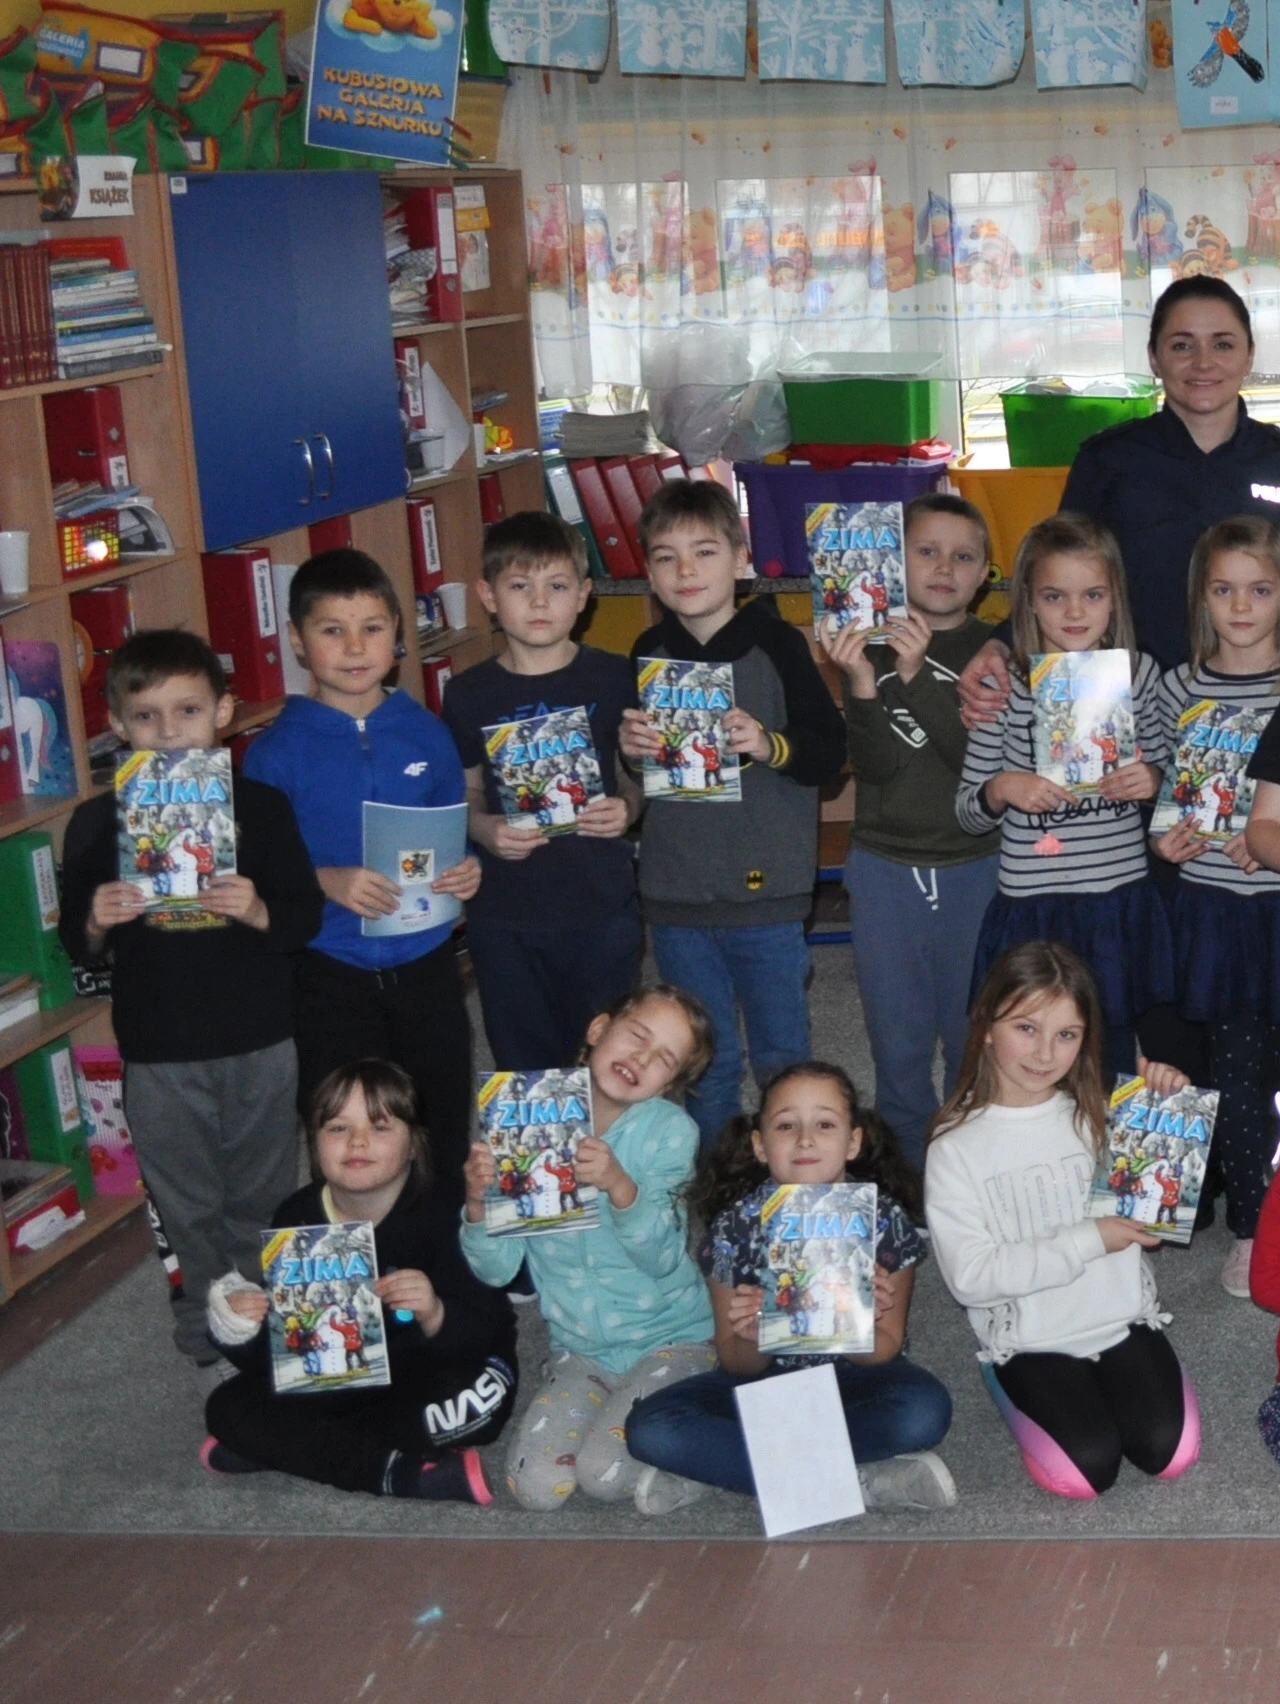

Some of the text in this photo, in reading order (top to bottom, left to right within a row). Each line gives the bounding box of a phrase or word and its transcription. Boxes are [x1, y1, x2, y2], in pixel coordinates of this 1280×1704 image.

[324, 67, 444, 99] KUBUSIOWA
[338, 88, 426, 116] GALERIA
[317, 104, 443, 138] NA SZNURKU
[823, 528, 898, 550] ZIMA
[653, 686, 729, 710] ZIMA
[506, 730, 588, 764] ZIMA
[1193, 723, 1259, 753] ZIMA
[403, 761, 429, 777] 4F
[136, 779, 226, 806] ZIMA
[498, 1099, 585, 1127] ZIMA
[1125, 1104, 1207, 1141] ZIMA
[781, 1212, 868, 1240] ZIMA
[281, 1257, 369, 1285] ZIMA
